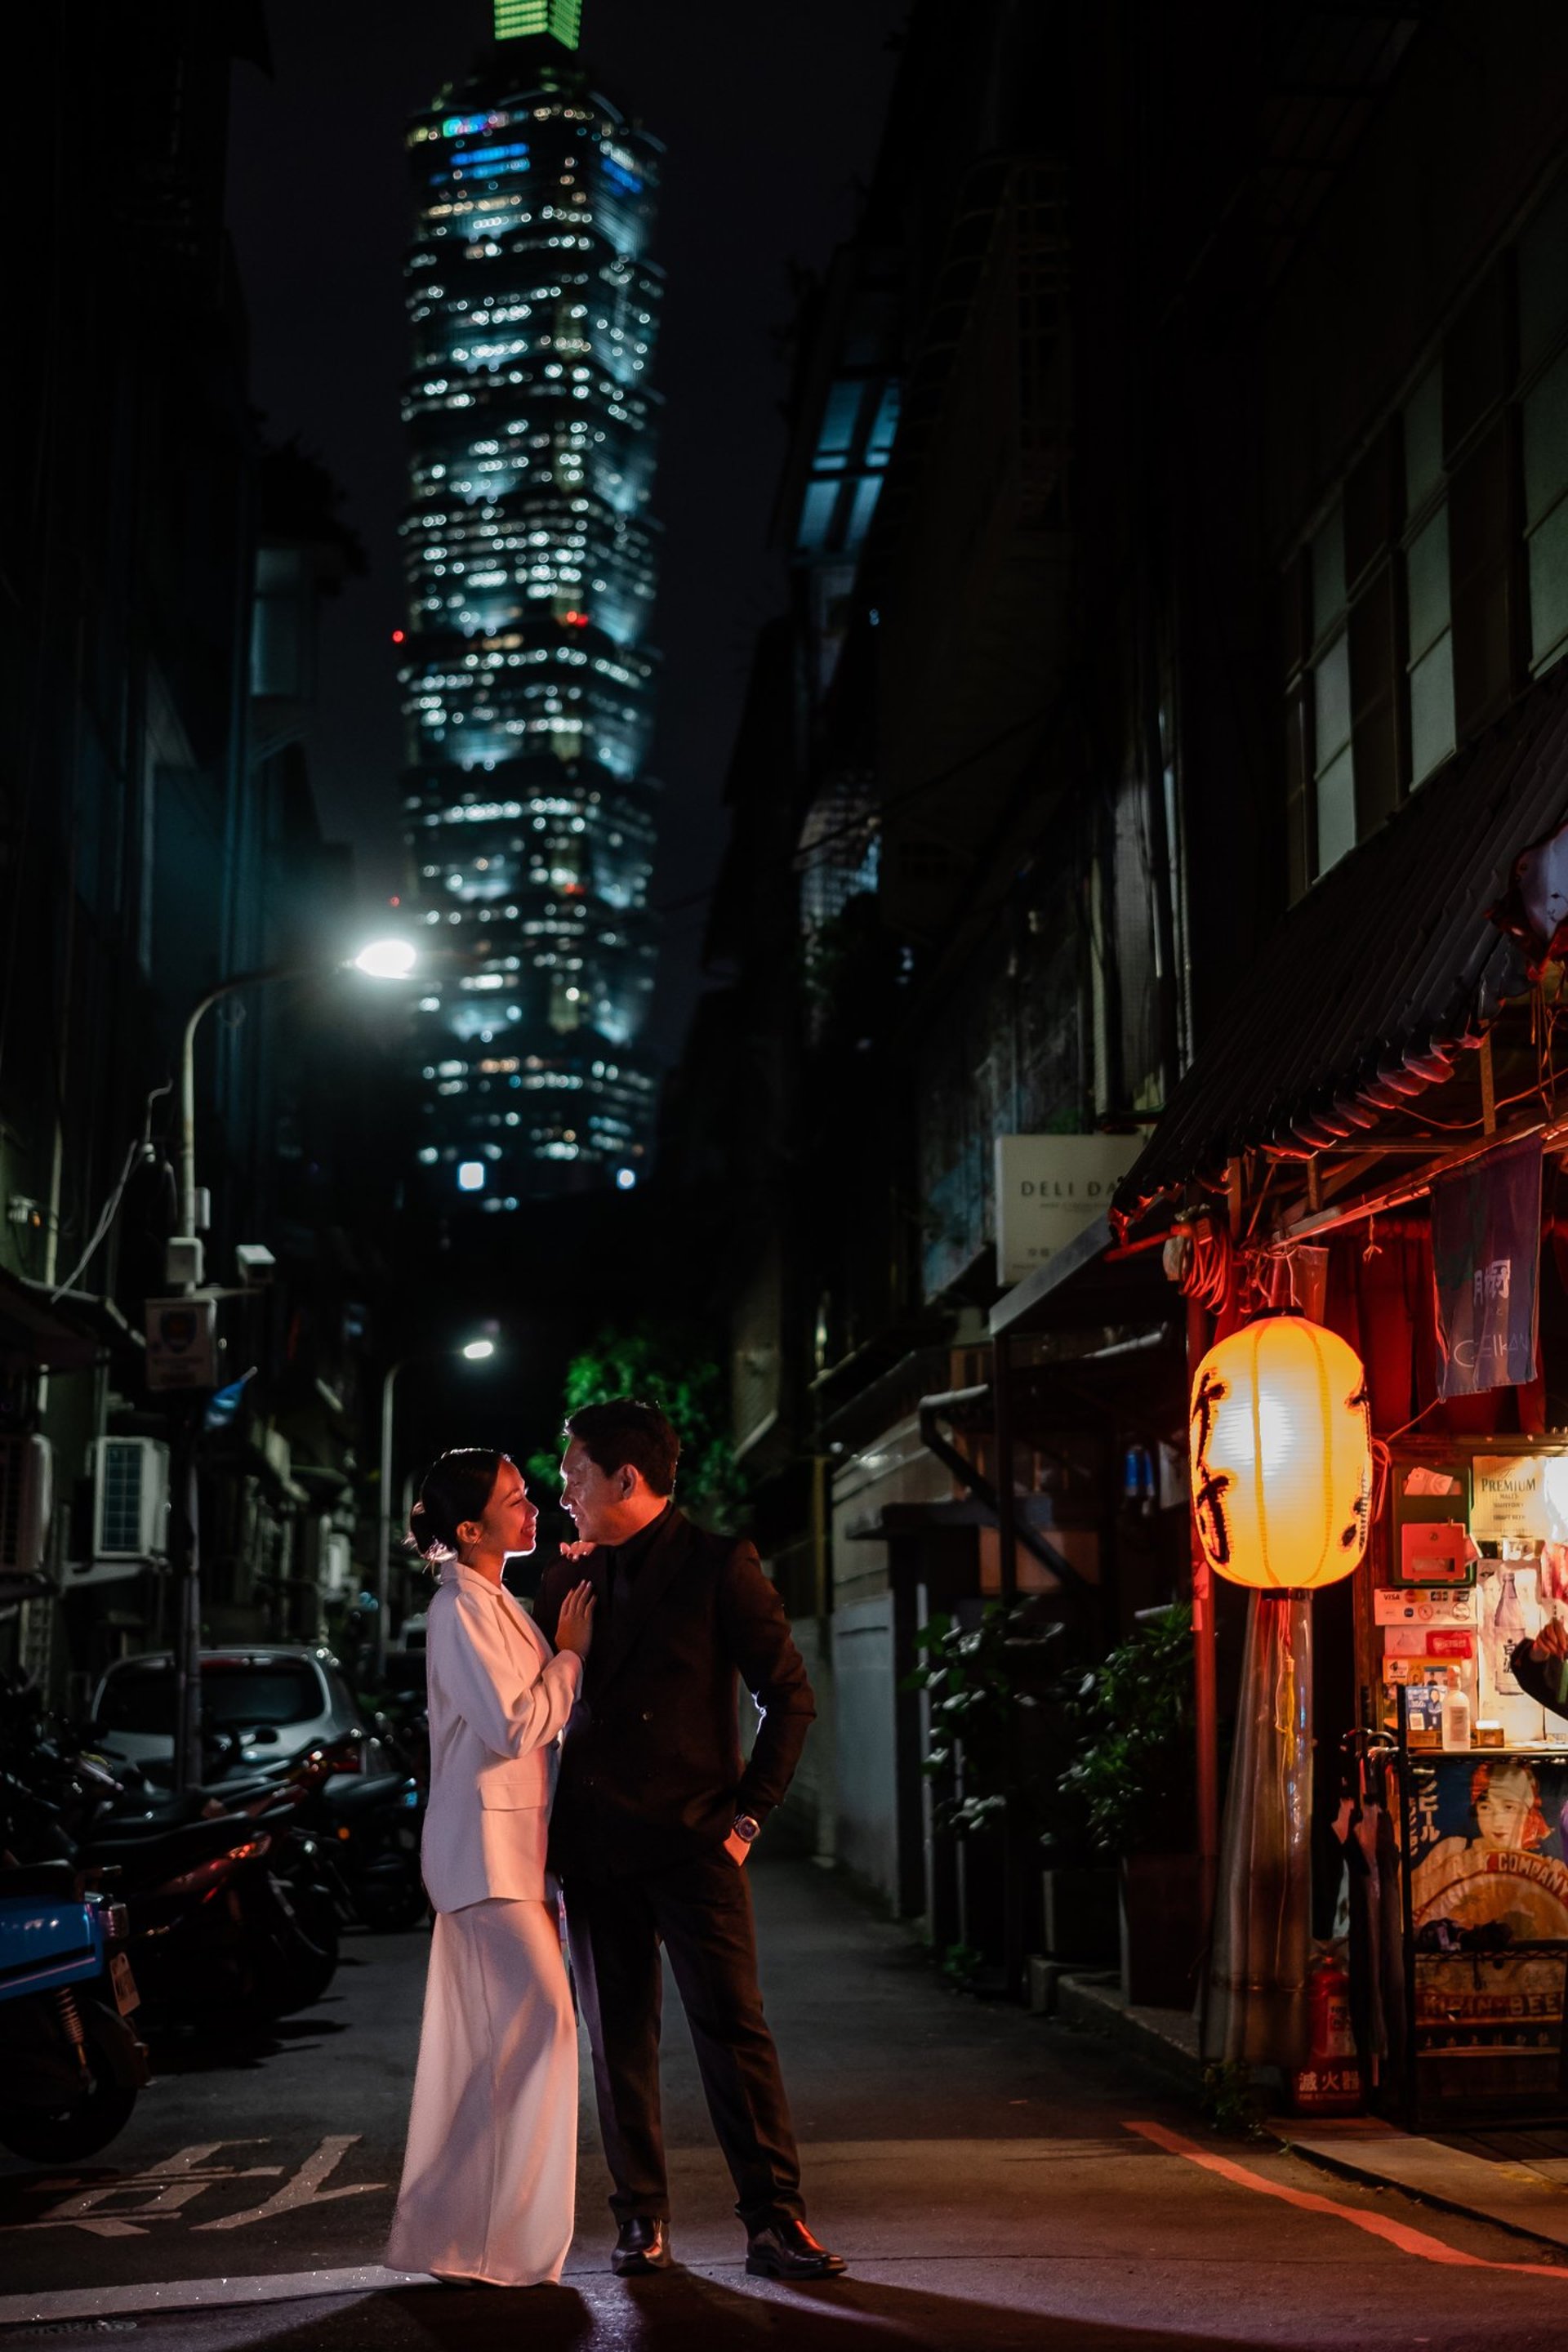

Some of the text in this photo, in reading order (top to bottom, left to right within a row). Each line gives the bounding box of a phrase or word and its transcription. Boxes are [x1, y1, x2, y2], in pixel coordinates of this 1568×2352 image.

[1021, 1181, 1116, 1196] DELI DA
[1481, 1477, 1536, 1492] PREMIUM
[1508, 1993, 1559, 2016] BEE
[1298, 2070, 1360, 2091] 滅火器
